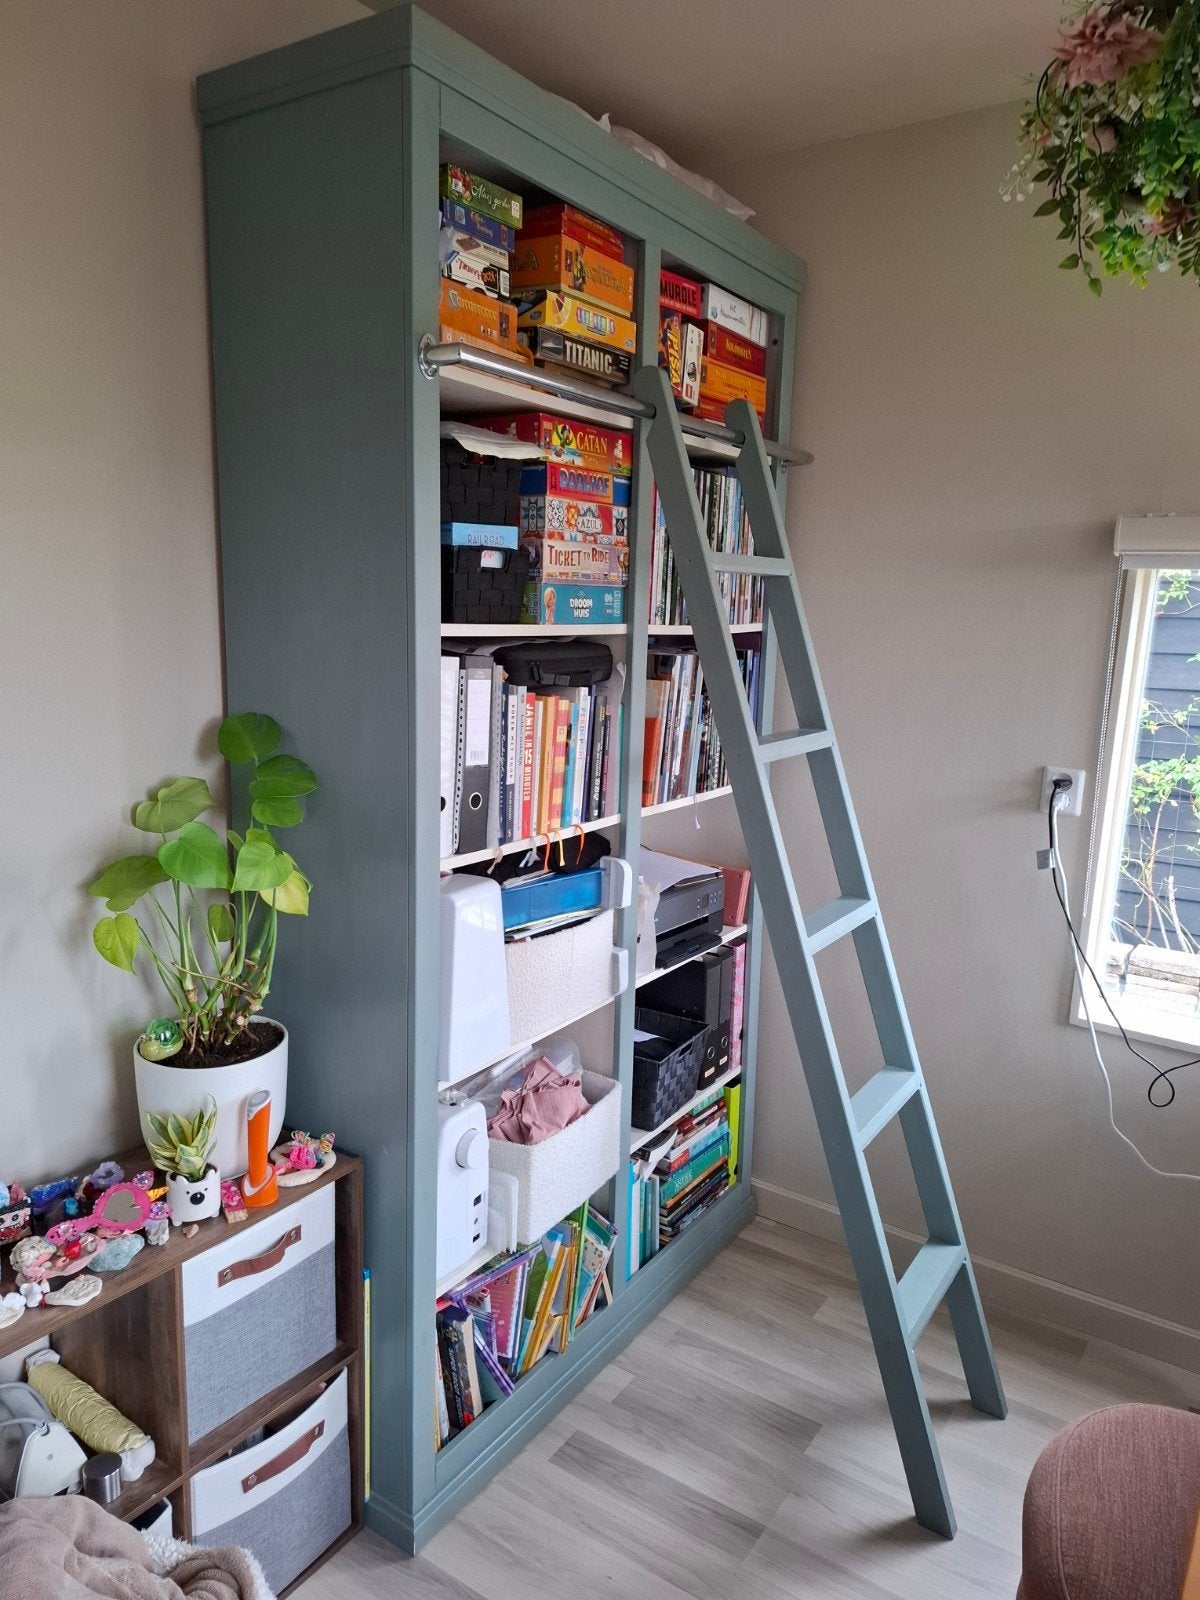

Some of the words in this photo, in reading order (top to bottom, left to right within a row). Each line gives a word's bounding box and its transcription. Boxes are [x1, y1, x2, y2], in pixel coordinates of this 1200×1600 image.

[660, 279, 697, 306] MURDLE
[564, 340, 613, 374] TITANIC
[576, 431, 608, 455] CATAN
[560, 467, 610, 494] DOOLHOF
[581, 519, 599, 530] AZUL
[467, 534, 505, 546] RAILROAD
[547, 544, 582, 567] TICKET
[583, 551, 591, 560] TO
[591, 547, 610, 564] RIDE
[569, 598, 593, 608] DROOM
[573, 608, 590, 618] HUIS
[525, 703, 534, 736] JAMIE
[525, 738, 533, 748] IN
[522, 767, 531, 801] MINUTEN
[449, 1348, 457, 1370] SUPER
[452, 1371, 460, 1394] GROOT
